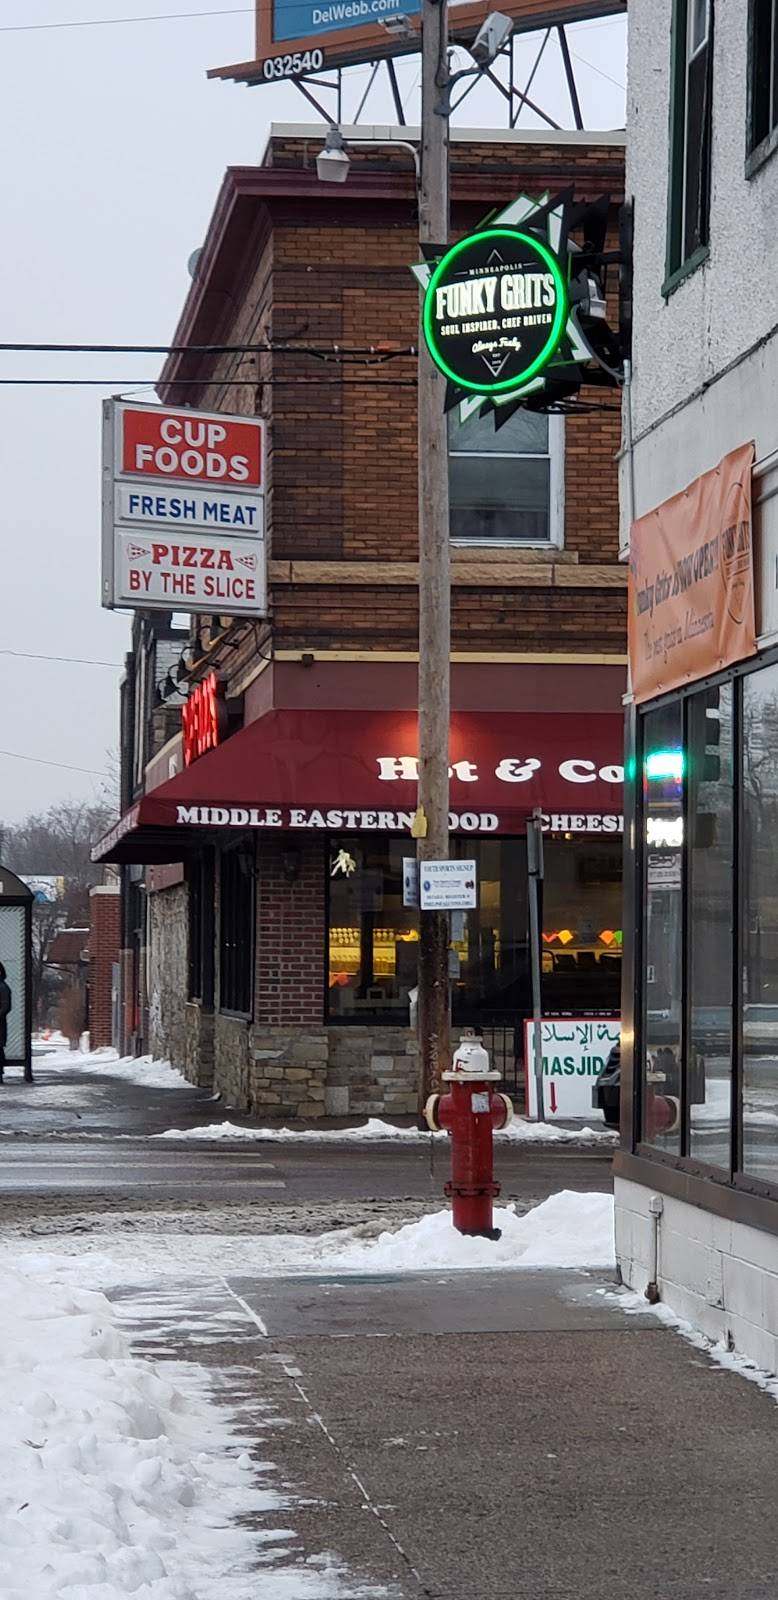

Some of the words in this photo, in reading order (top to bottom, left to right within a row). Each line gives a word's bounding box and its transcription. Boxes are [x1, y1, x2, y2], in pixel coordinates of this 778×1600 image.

[312, 0, 399, 24] DelWebb.com
[263, 49, 323, 79] 032540
[469, 263, 523, 276] MINNEAPOLIS
[436, 276, 498, 320] FUNKY
[500, 273, 556, 311] GRITS
[440, 324, 460, 336] SOUL
[501, 316, 522, 329] CHEF
[523, 313, 553, 327] DRIVEN
[160, 418, 227, 449] CUP
[135, 444, 250, 481] FOODS
[129, 494, 196, 520] FRESH
[203, 501, 257, 526] MEAT
[151, 543, 235, 571] PIZZA
[129, 570, 152, 591] BY
[160, 572, 196, 595] THE
[203, 575, 256, 600] SLICE
[376, 756, 479, 782] Ht
[494, 757, 542, 783] &
[176, 805, 282, 826] MIDDLE
[288, 808, 416, 830] EASTERN
[448, 811, 499, 832] OOD
